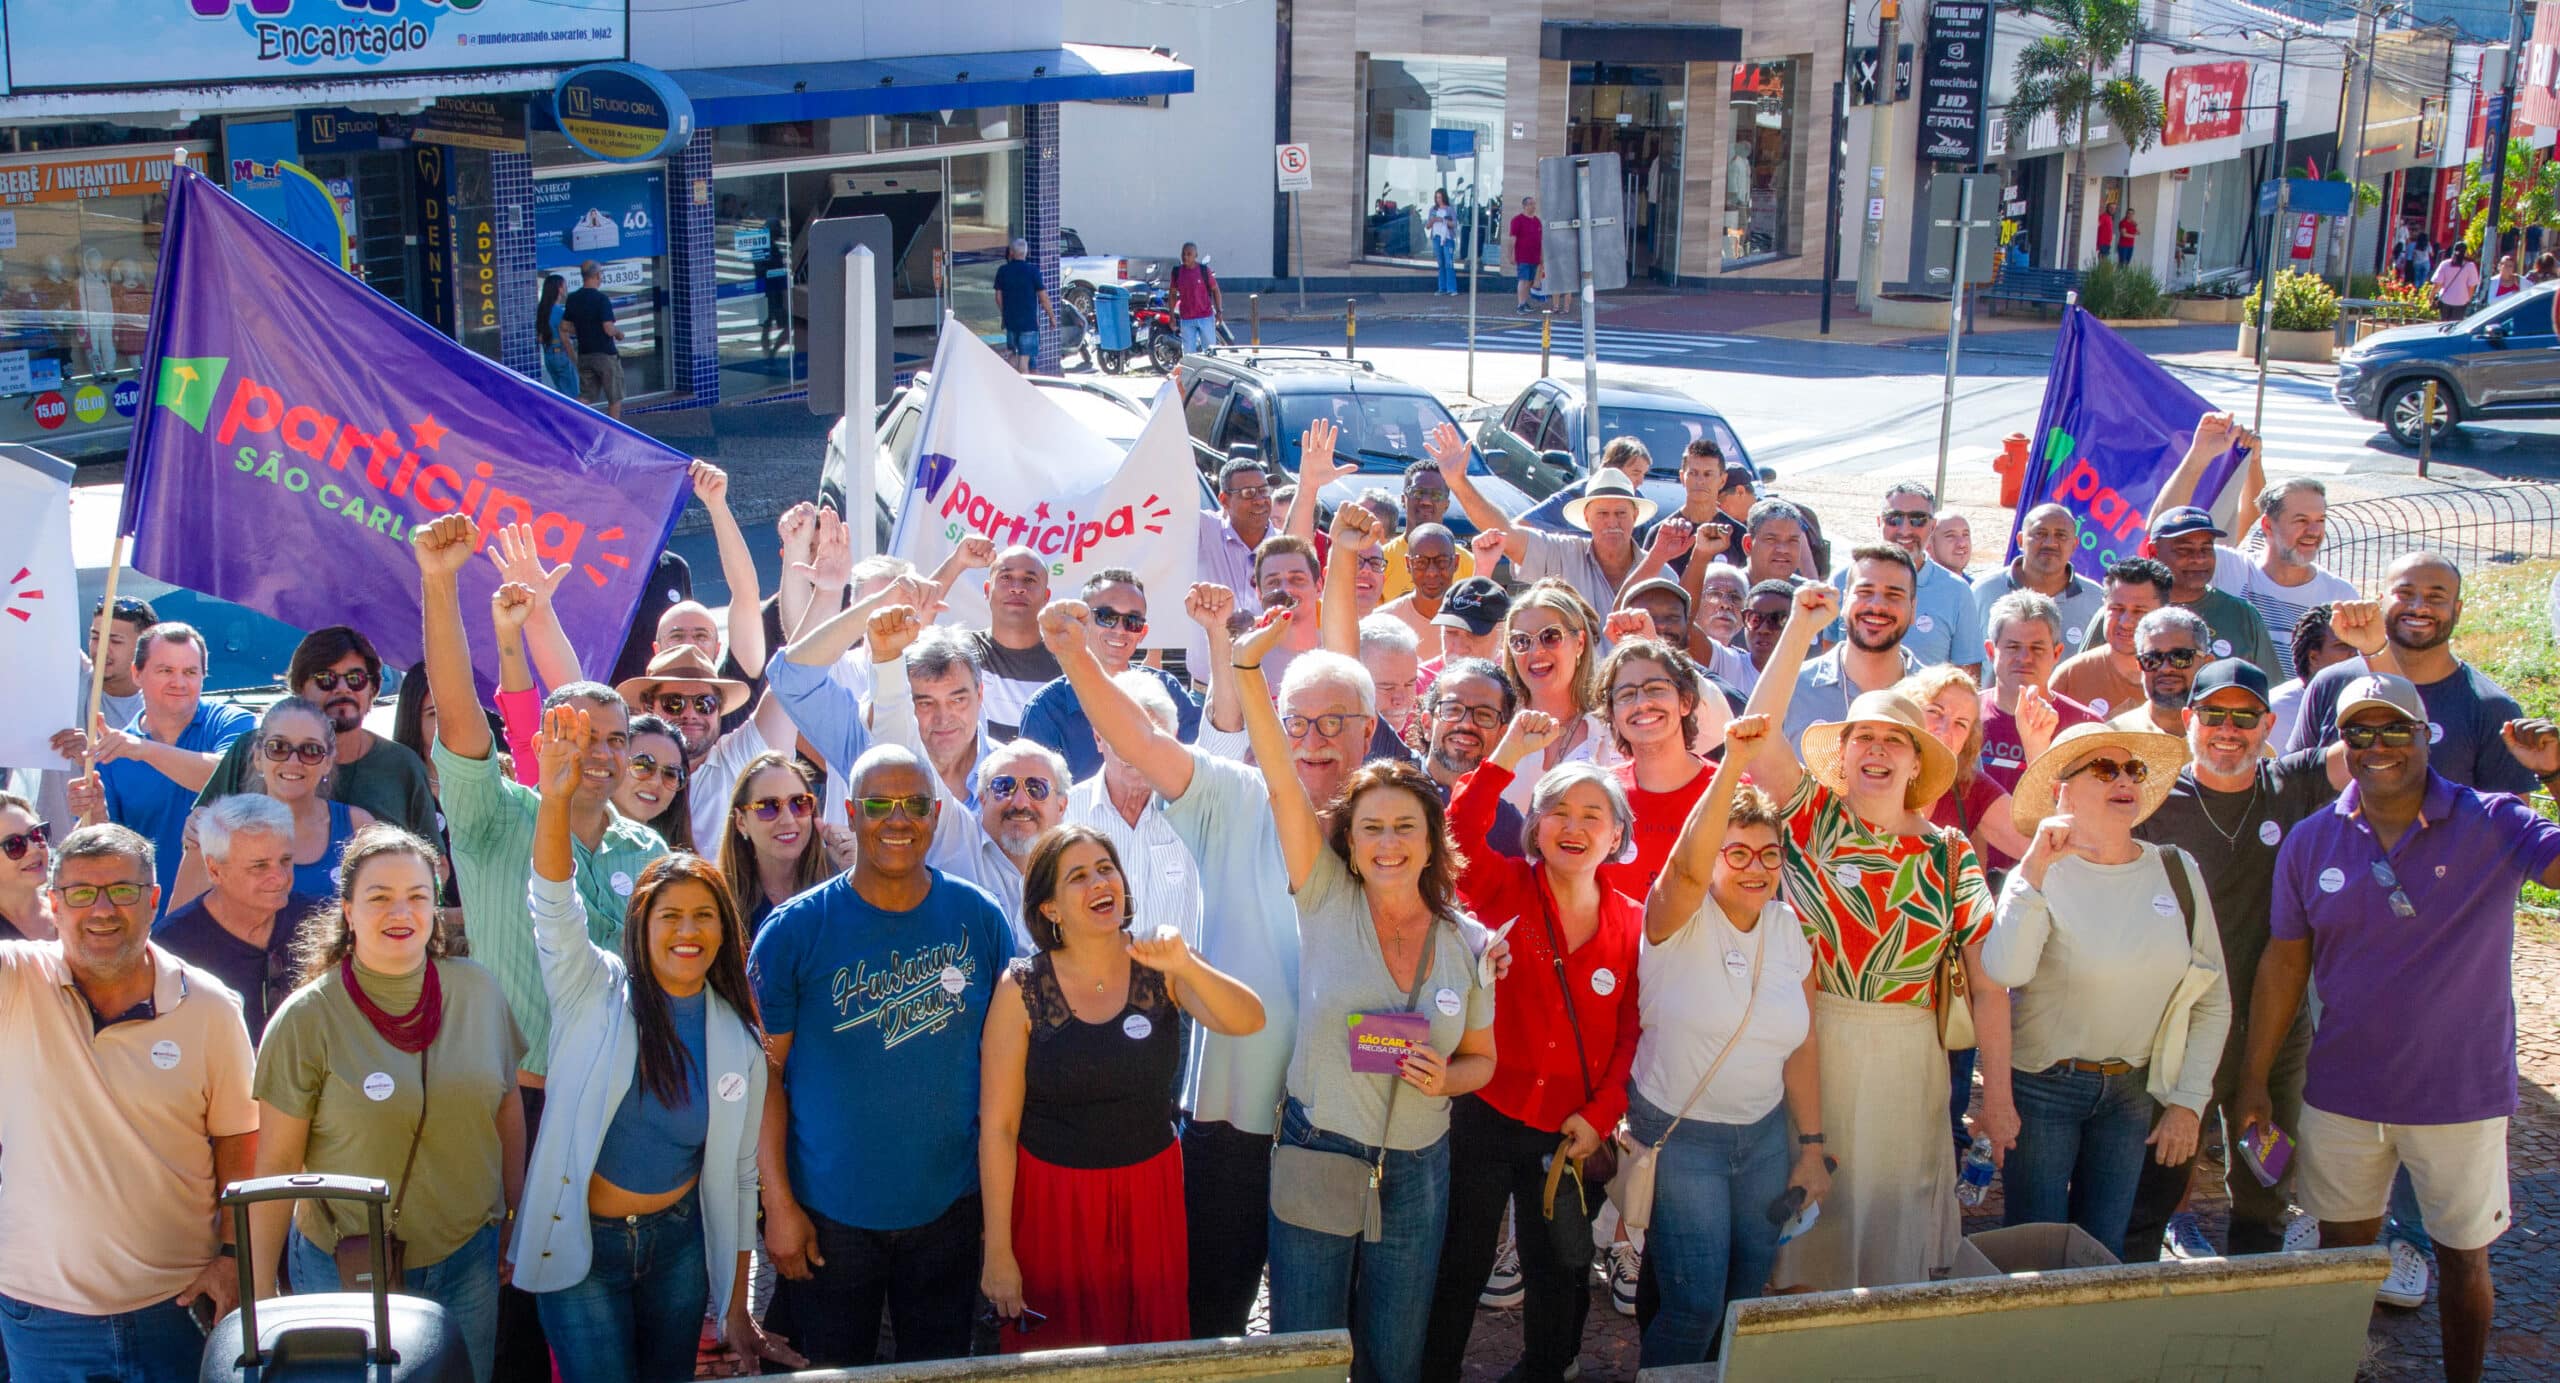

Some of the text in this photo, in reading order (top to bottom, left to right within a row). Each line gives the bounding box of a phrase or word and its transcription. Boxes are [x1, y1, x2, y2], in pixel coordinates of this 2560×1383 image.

[257, 20, 427, 60] Encantado
[593, 98, 629, 112] STUDIO
[1937, 116, 1974, 129] FATAL
[337, 120, 374, 134] STUDIO
[0, 166, 40, 195] BEBÊ
[57, 162, 130, 190] INFANTIL
[623, 211, 648, 230] 40
[216, 377, 586, 564] participa
[234, 446, 418, 546] SÃO CARL
[940, 475, 1135, 563] participa
[832, 922, 969, 1016] Hawaiian
